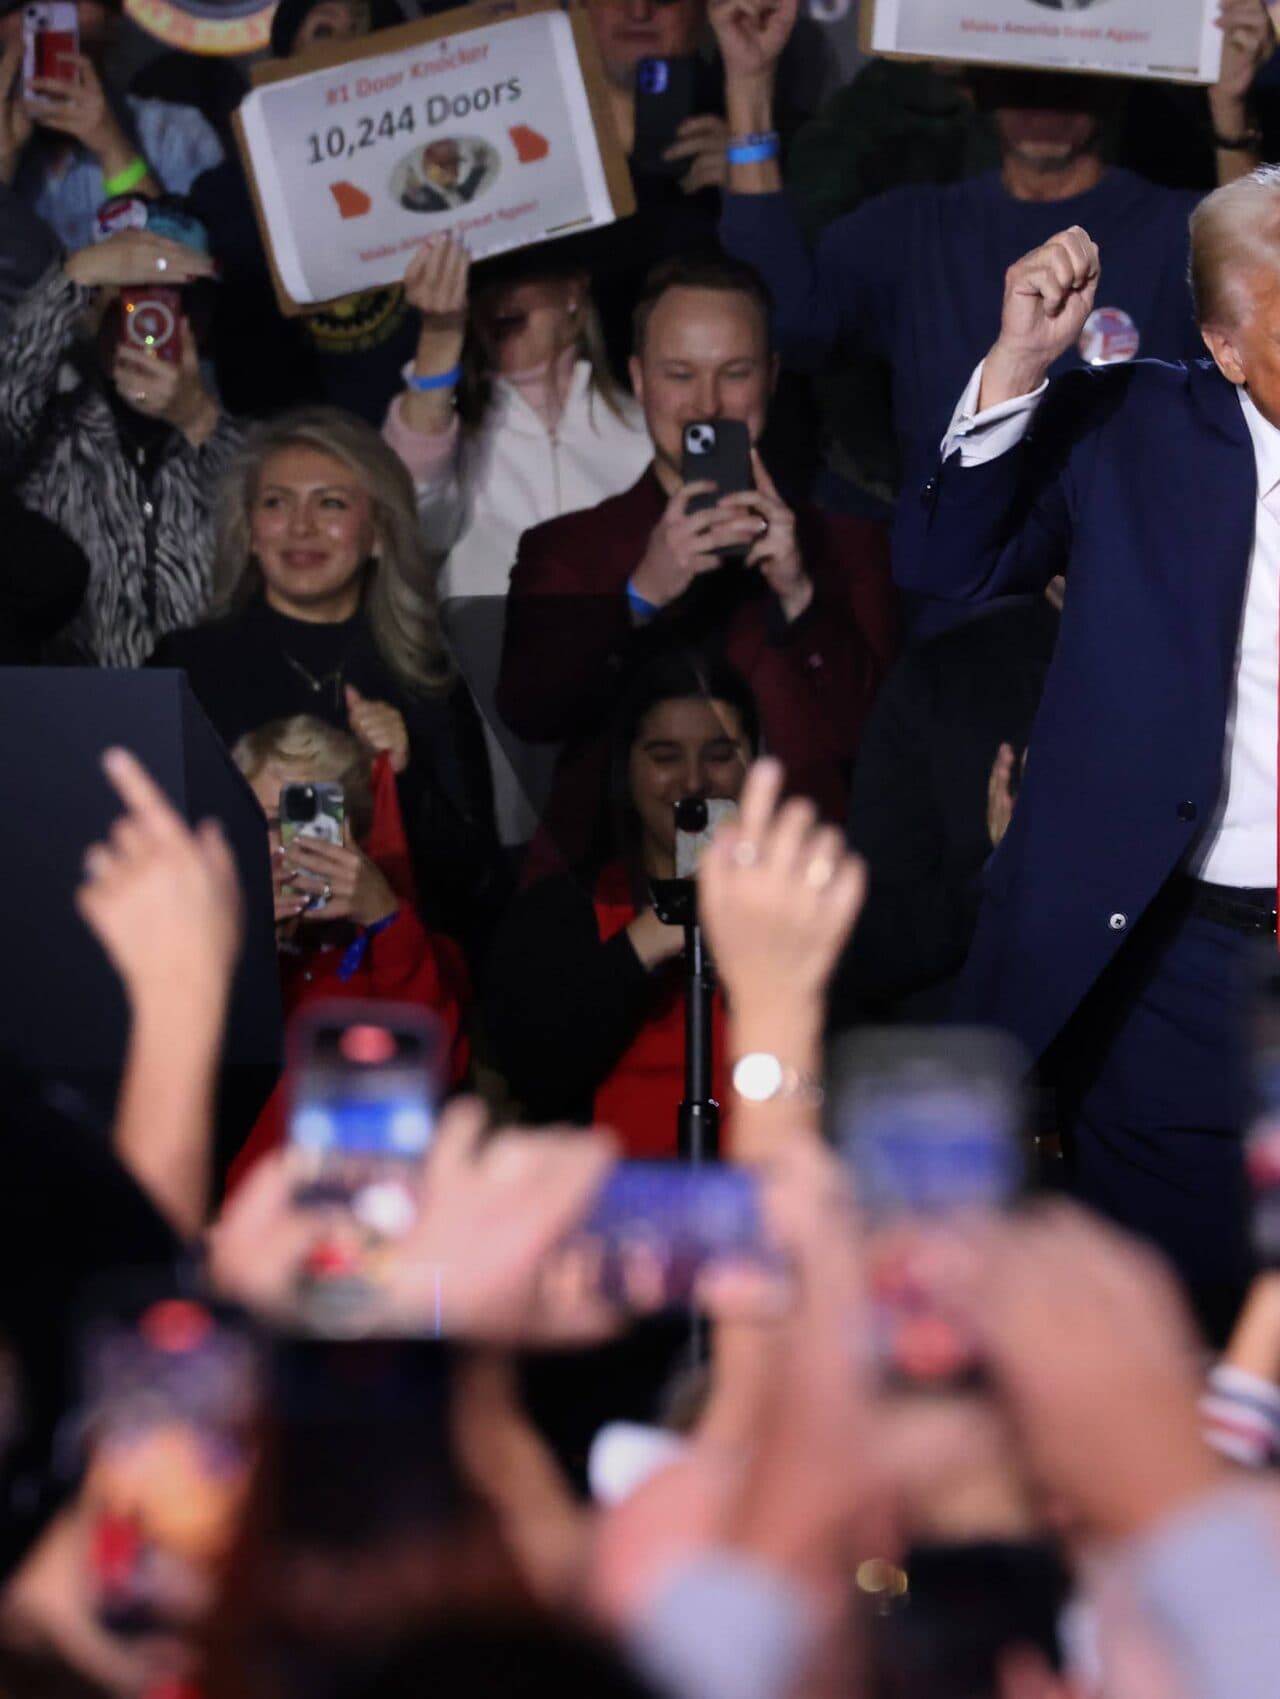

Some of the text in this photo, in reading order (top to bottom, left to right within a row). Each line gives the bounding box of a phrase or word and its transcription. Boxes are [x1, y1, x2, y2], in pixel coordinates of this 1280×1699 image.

[326, 44, 491, 106] #1 Door Knocker
[308, 76, 523, 165] 10,244 Doors
